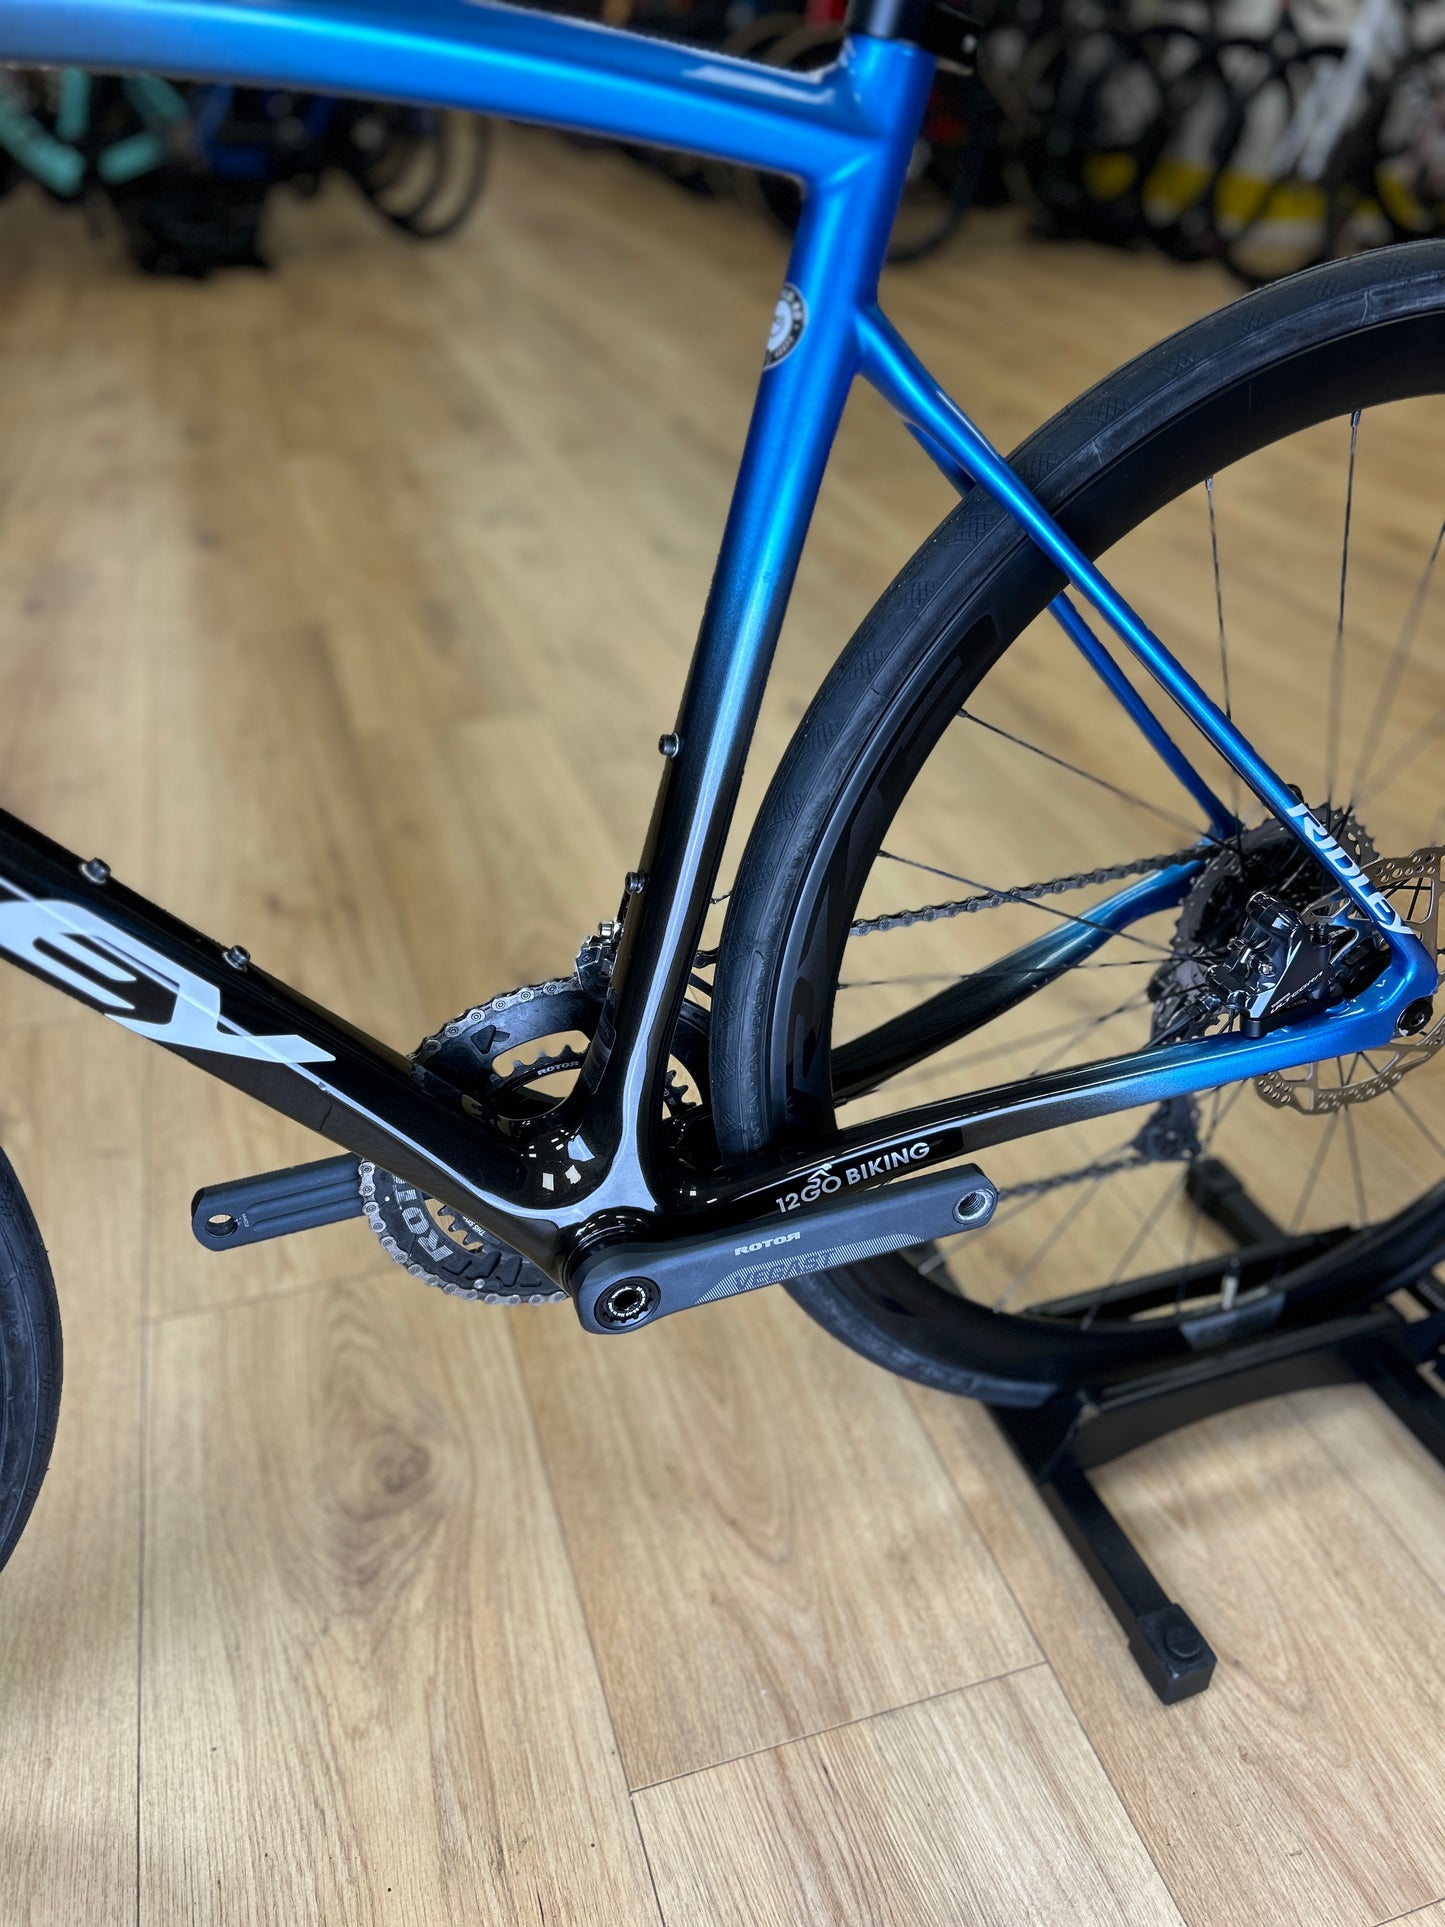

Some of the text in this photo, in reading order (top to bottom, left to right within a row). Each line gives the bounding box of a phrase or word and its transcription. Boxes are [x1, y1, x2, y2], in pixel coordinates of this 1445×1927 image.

[1285, 802, 1415, 935] RIDLEY
[537, 1060, 579, 1076] ROTOR
[775, 1142, 930, 1214] 12GO BIKING
[391, 1174, 454, 1262] ROT
[734, 1231, 801, 1256] ROTOR
